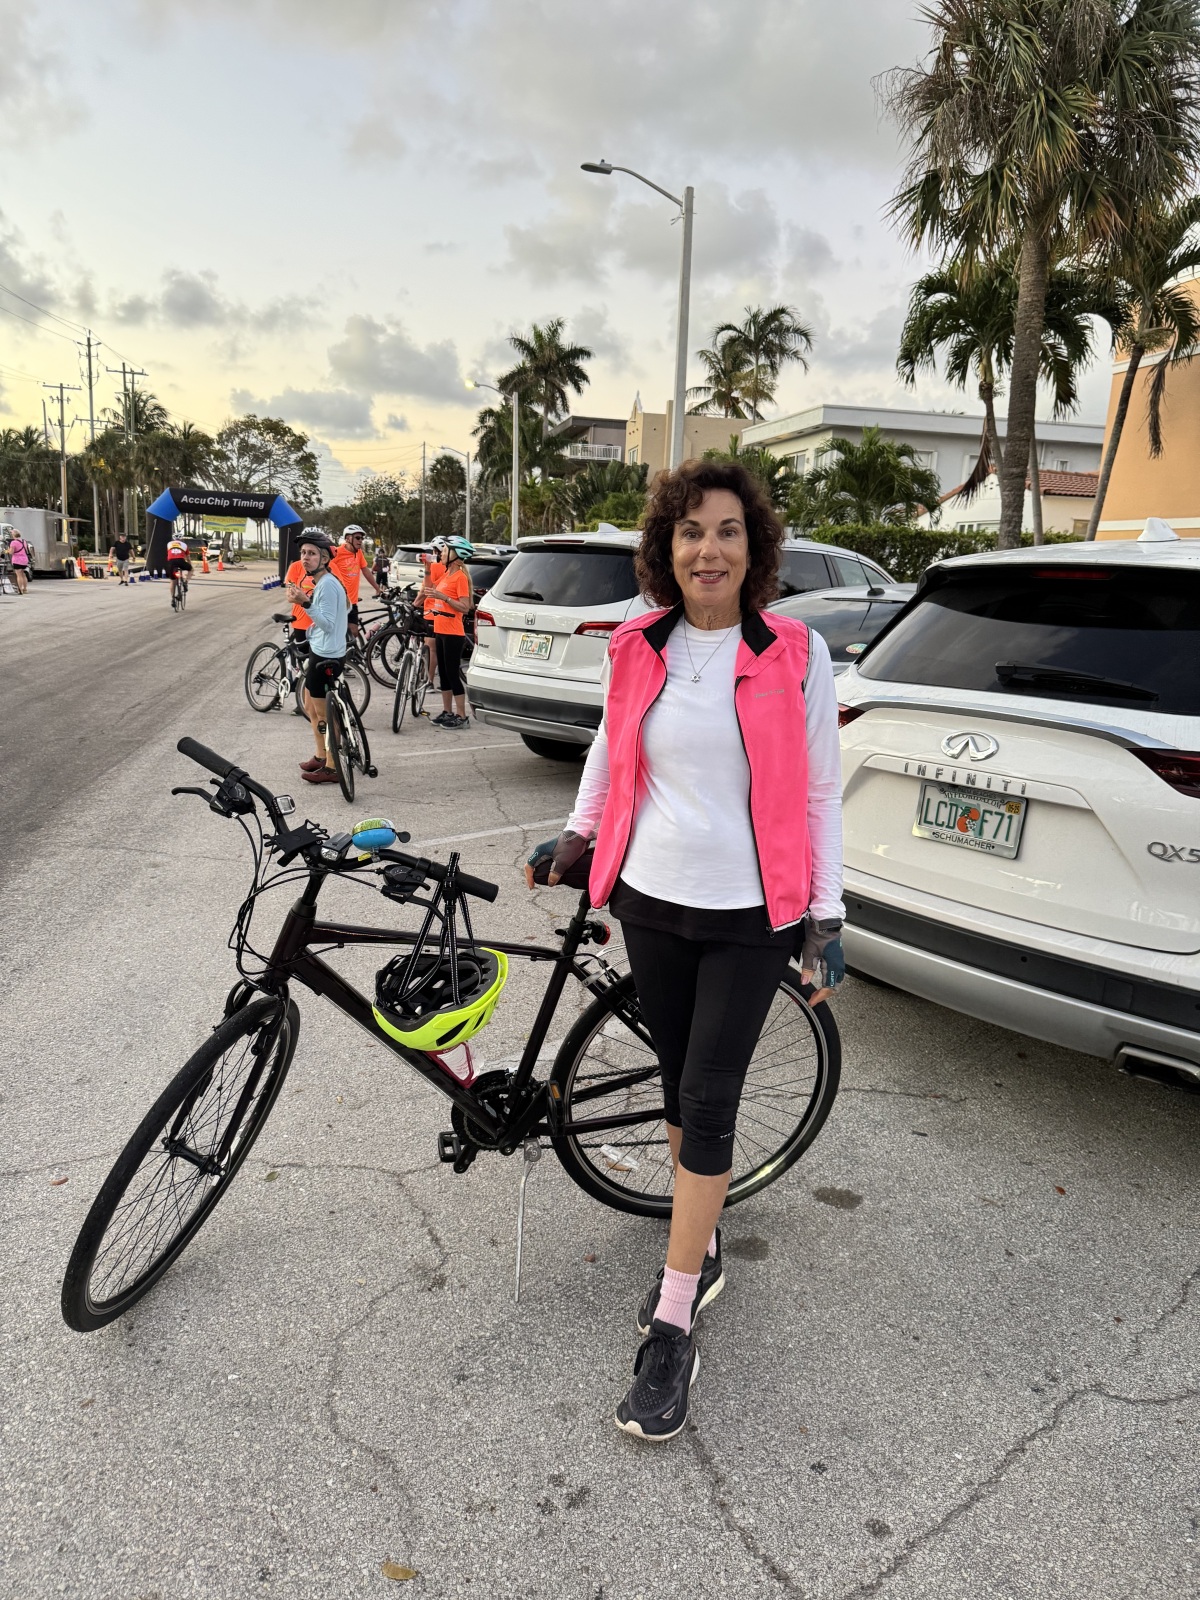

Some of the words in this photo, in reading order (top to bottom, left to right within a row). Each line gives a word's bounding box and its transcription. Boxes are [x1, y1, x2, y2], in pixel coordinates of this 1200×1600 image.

[232, 498, 265, 509] Timing
[903, 761, 1028, 796] INFINITI
[923, 797, 959, 830] LCD
[978, 808, 1014, 842] F71
[934, 831, 992, 851] SCHUMACHER
